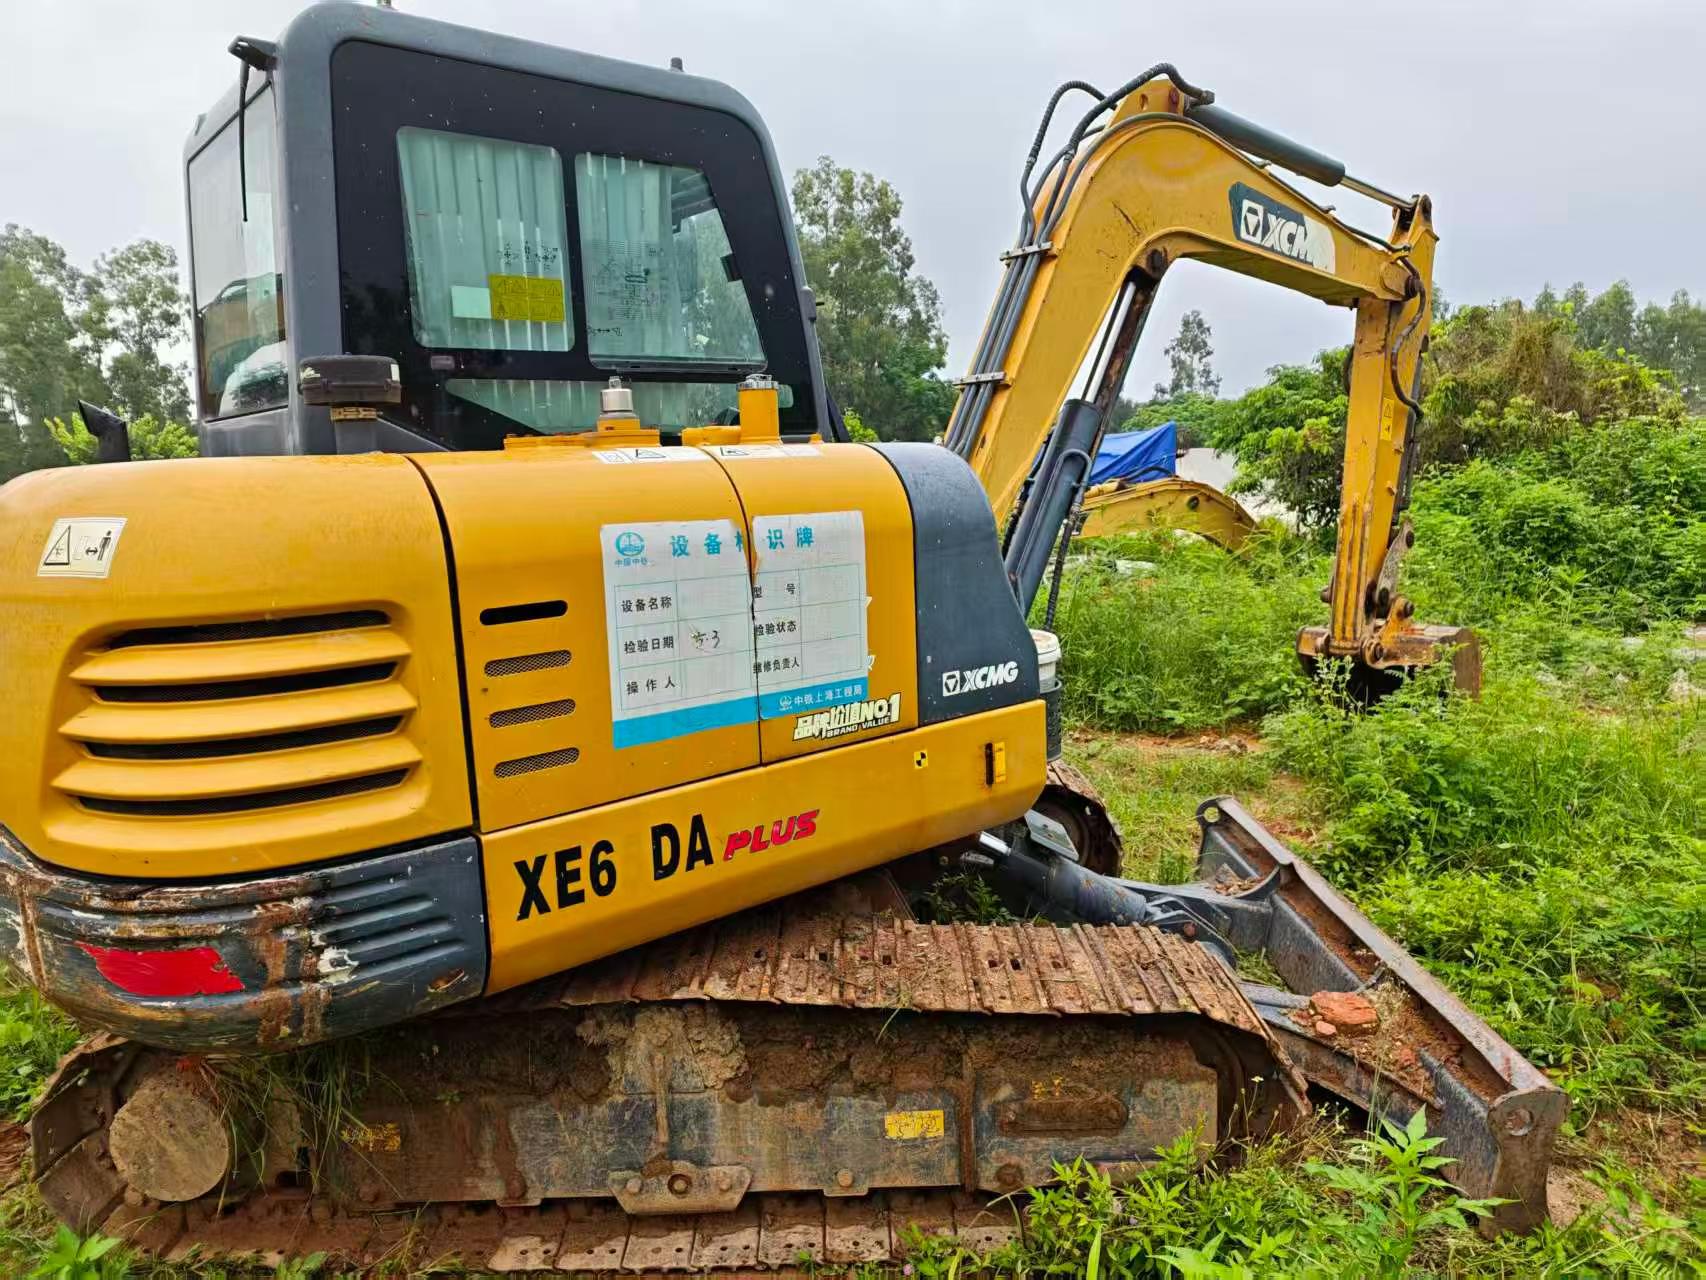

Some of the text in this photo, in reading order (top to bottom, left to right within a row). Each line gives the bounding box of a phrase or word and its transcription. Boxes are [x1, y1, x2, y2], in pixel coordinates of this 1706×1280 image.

[1261, 212, 1312, 262] XCM
[621, 596, 672, 613] 设备名称
[755, 620, 797, 637] 检验状态
[624, 636, 674, 654] 检验日期
[753, 656, 800, 674] 维修负责人
[626, 675, 676, 696] 操作人
[962, 661, 1018, 692] XCMG
[826, 717, 892, 738] BRAND VALUE
[723, 809, 820, 861] PLUS
